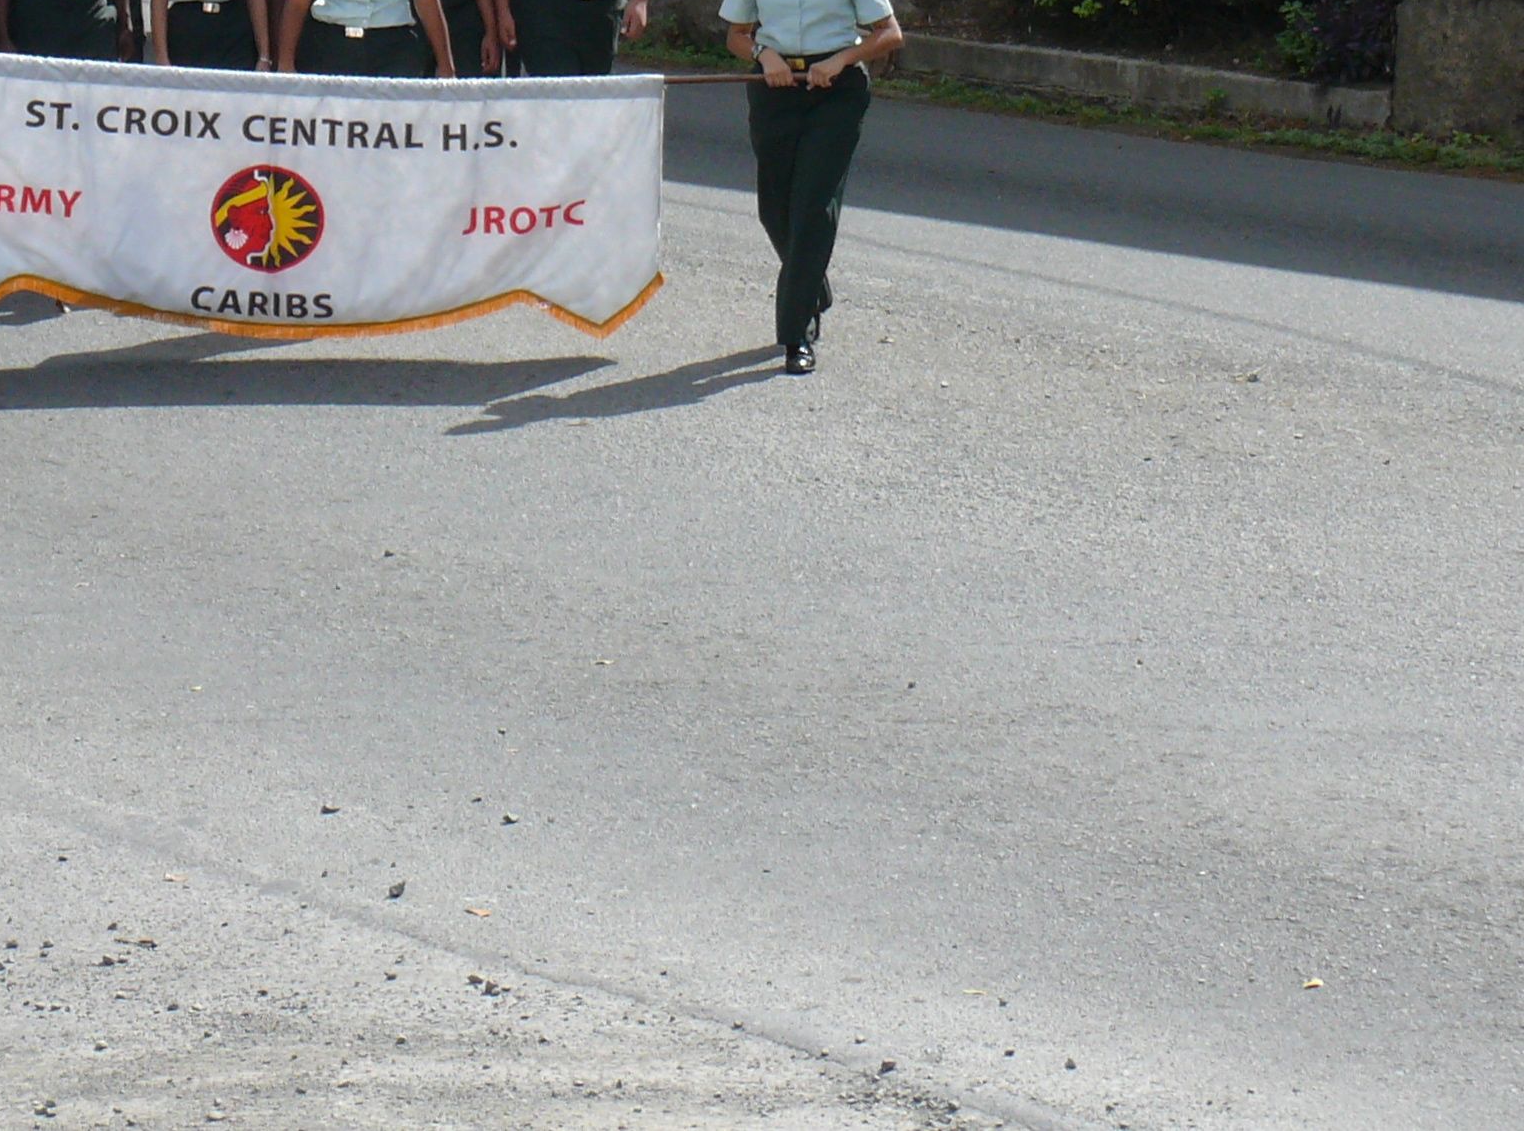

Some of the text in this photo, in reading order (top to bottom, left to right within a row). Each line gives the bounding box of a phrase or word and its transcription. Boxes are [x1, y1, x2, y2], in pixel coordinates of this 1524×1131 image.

[25, 100, 518, 151] ST. CROIX CENTRAL H.S.
[462, 199, 585, 235] JROTC
[190, 286, 334, 319] CARIBS
